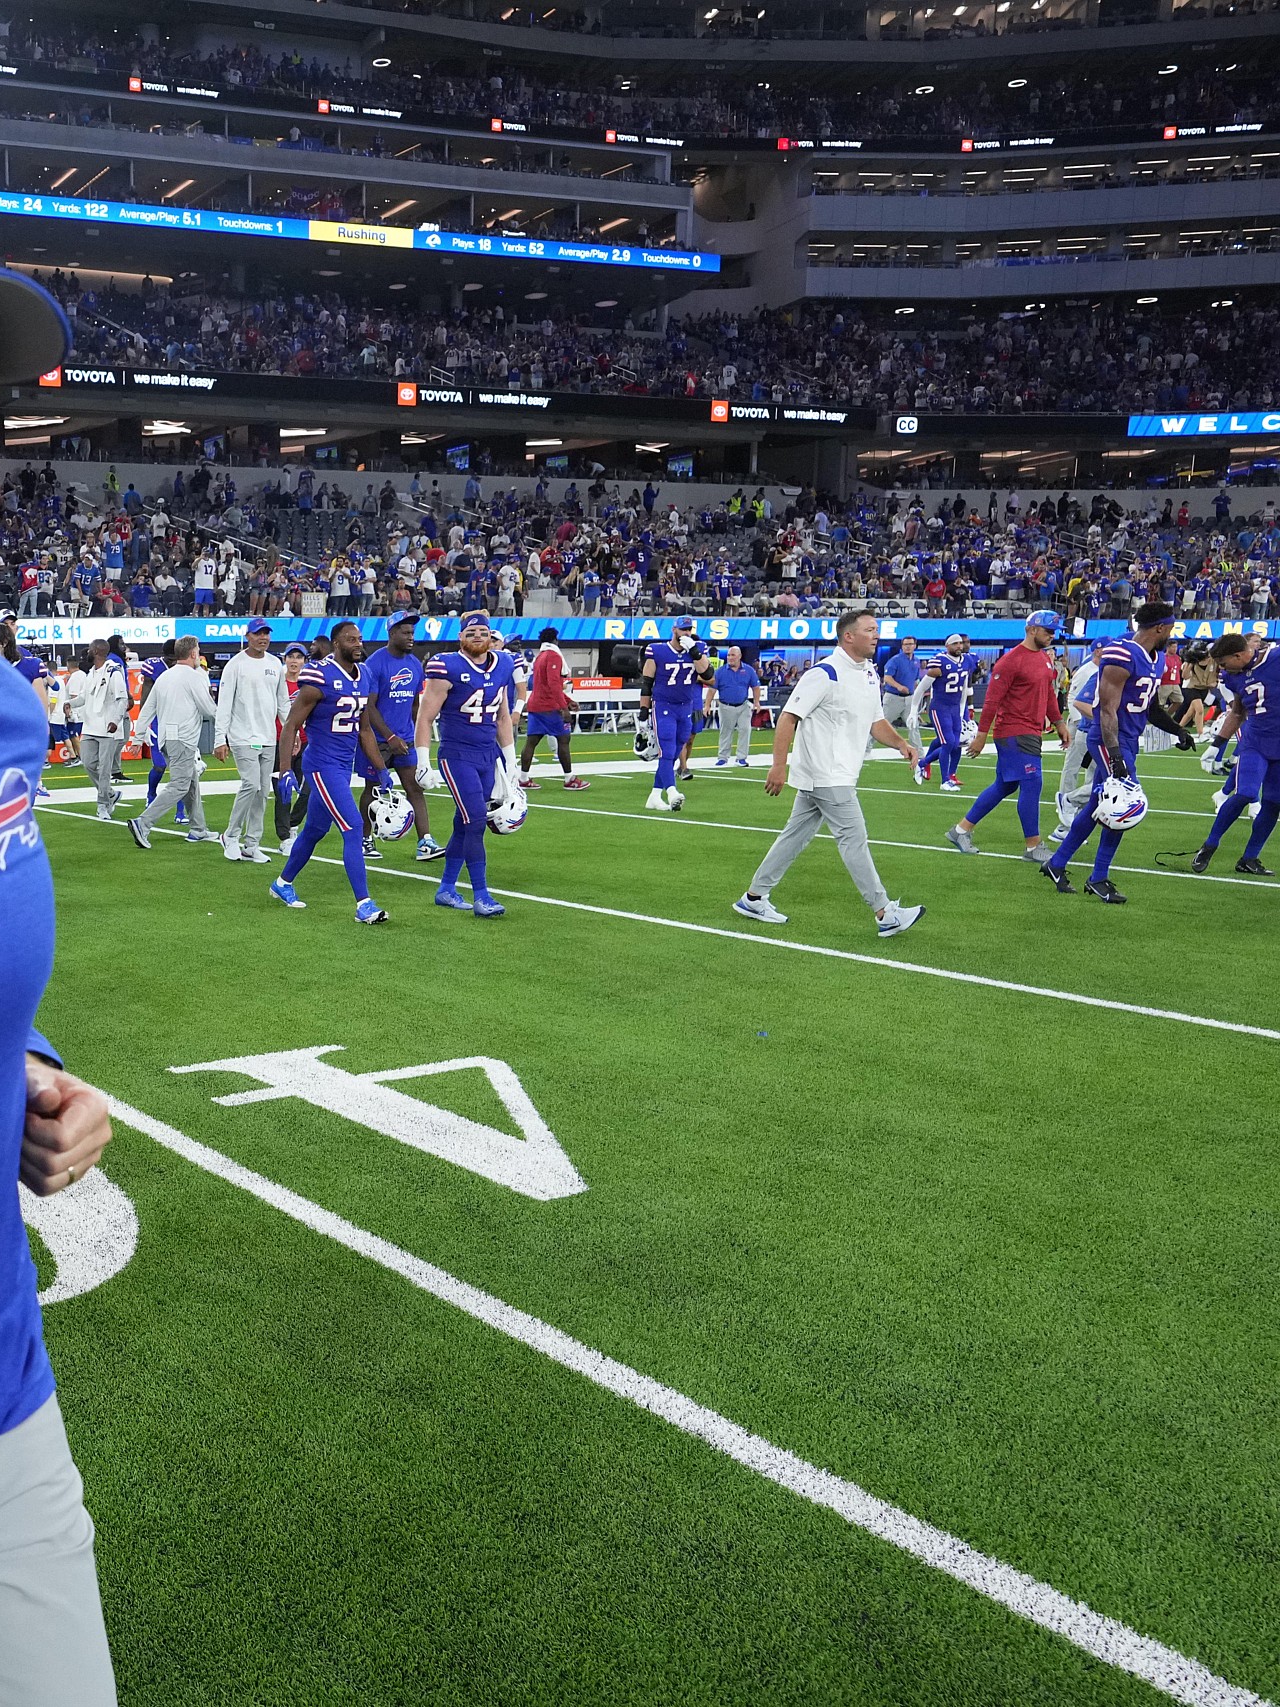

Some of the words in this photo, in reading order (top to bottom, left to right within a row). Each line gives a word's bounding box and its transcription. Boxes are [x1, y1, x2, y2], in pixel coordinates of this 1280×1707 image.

[142, 82, 168, 91] TOYOTA
[330, 104, 354, 113] TOYOTA
[503, 122, 526, 131] TOYOTA
[1178, 127, 1205, 136] TOYOTA
[617, 134, 639, 142] TOYOTA
[974, 141, 1000, 149] TOYOTA
[23, 198, 42, 212] 24
[52, 202, 81, 215] Yards:
[84, 203, 109, 218] 122
[119, 207, 180, 225] Average/Play:
[183, 211, 201, 226] 5.1
[218, 216, 273, 233] Touchdowns:
[276, 220, 283, 233] 1
[338, 226, 386, 243] Rushing
[478, 238, 492, 251] 18
[529, 243, 545, 256] 52
[612, 249, 631, 262] 2.9
[693, 254, 702, 267] 0
[65, 368, 116, 384] TOYOTA
[133, 373, 150, 385] we
[151, 373, 180, 386] make
[181, 374, 188, 387] it
[189, 377, 215, 390] easy
[420, 389, 463, 403] TOYOTA
[479, 392, 494, 403] we
[494, 393, 518, 405] make
[519, 393, 526, 405] it
[731, 406, 770, 419] TOYOTA
[783, 409, 796, 419] we
[797, 409, 819, 420] make
[899, 419, 915, 431] CC
[110, 545, 121, 554] 79
[564, 554, 573, 563] 17
[637, 553, 644, 562] 5
[204, 564, 213, 575] 17
[81, 575, 91, 585] 13
[337, 574, 344, 585] 9
[353, 575, 361, 583] 17
[628, 578, 636, 588] 17
[721, 578, 729, 588] 12
[1195, 582, 1204, 592] 17
[17, 625, 47, 640] 2nd
[52, 625, 63, 639] &
[133, 628, 149, 637] On
[155, 625, 170, 638] 15
[206, 624, 248, 637] RAM
[605, 619, 730, 640] RAS
[760, 620, 898, 640] HOUE
[666, 653, 697, 686] 77
[460, 672, 471, 682] C
[333, 680, 343, 689] C
[579, 679, 612, 688] GATORADE
[1244, 681, 1267, 714] 7
